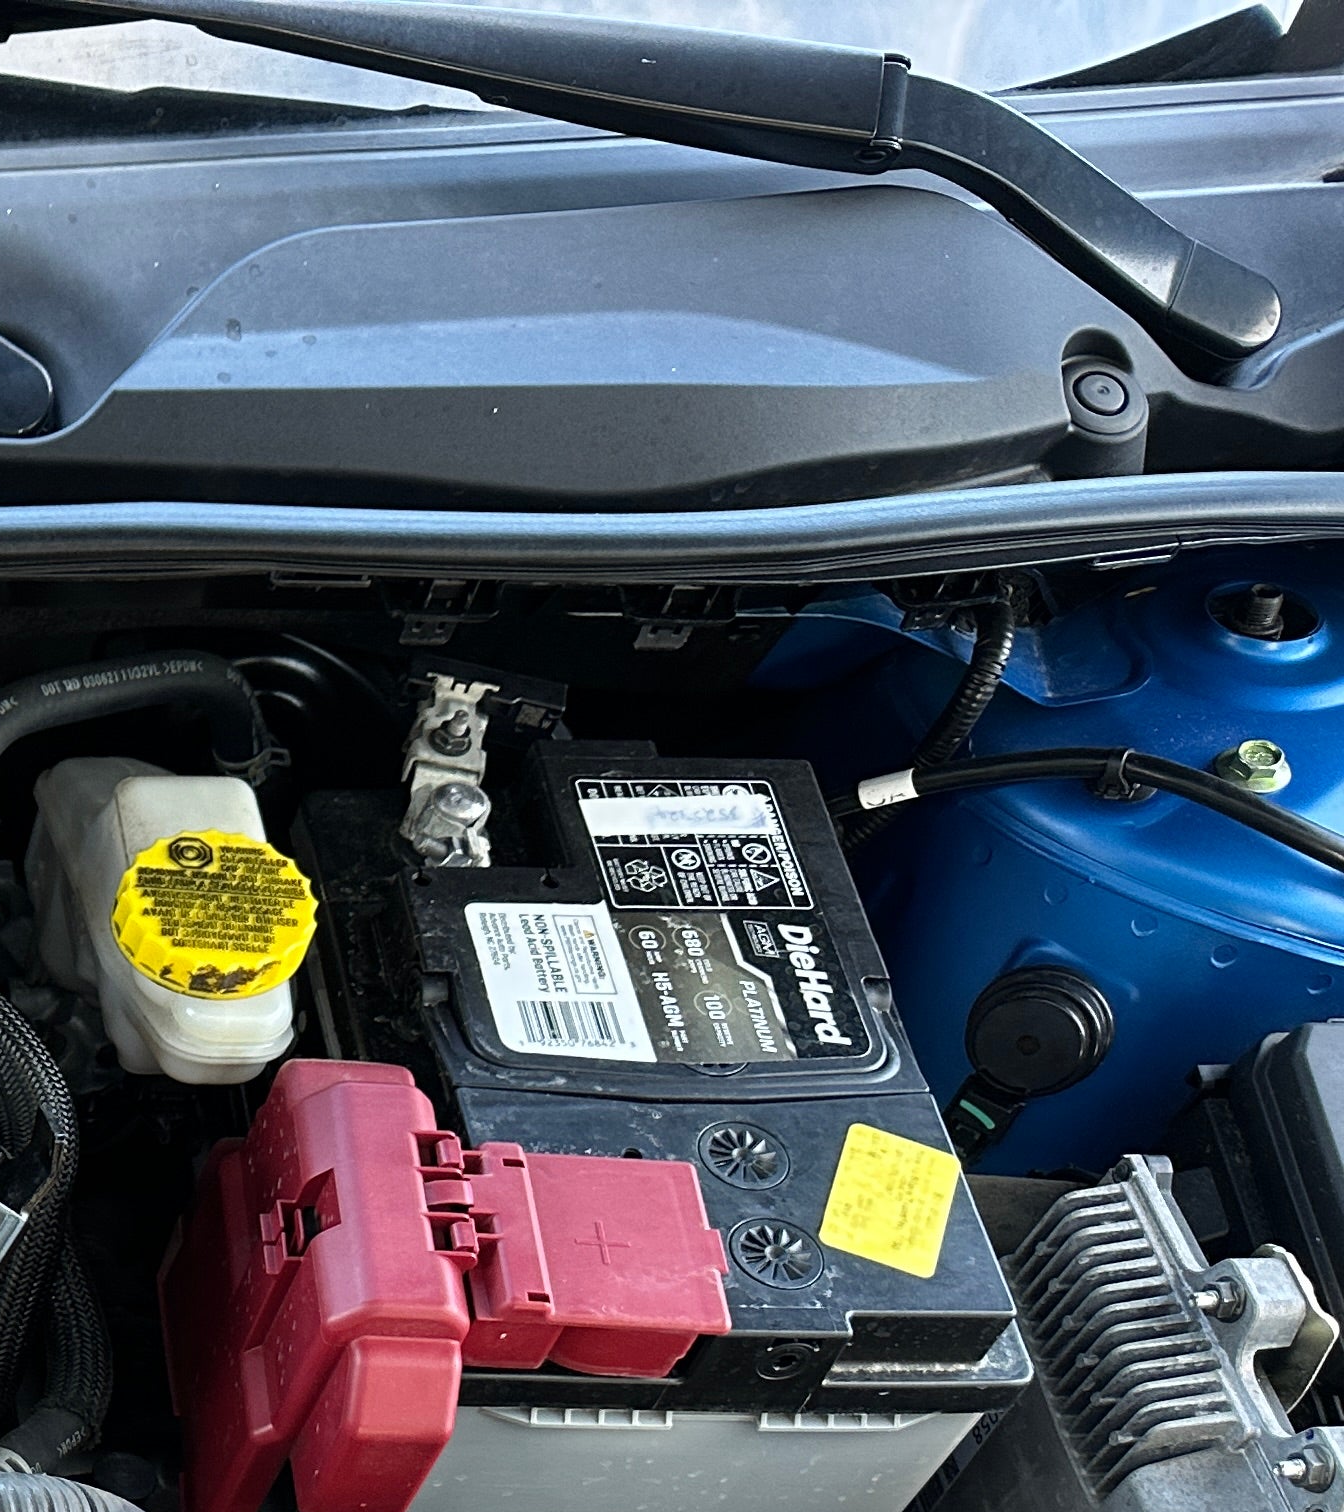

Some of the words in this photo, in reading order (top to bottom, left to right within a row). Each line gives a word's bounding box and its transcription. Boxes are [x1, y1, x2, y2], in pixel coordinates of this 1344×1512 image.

[518, 913, 532, 936] Lead
[638, 930, 659, 950] 60
[752, 923, 776, 956] AGM
[526, 936, 540, 957] Acid
[533, 913, 569, 994] NON-SPILLABLE
[588, 939, 606, 980] WARNING:
[681, 929, 705, 958] 680
[532, 958, 551, 994] Battery
[777, 923, 853, 1047] DieHard
[651, 972, 685, 1028] H5-AGM
[703, 995, 726, 1020] 100
[739, 980, 778, 1054] PLATINUM
